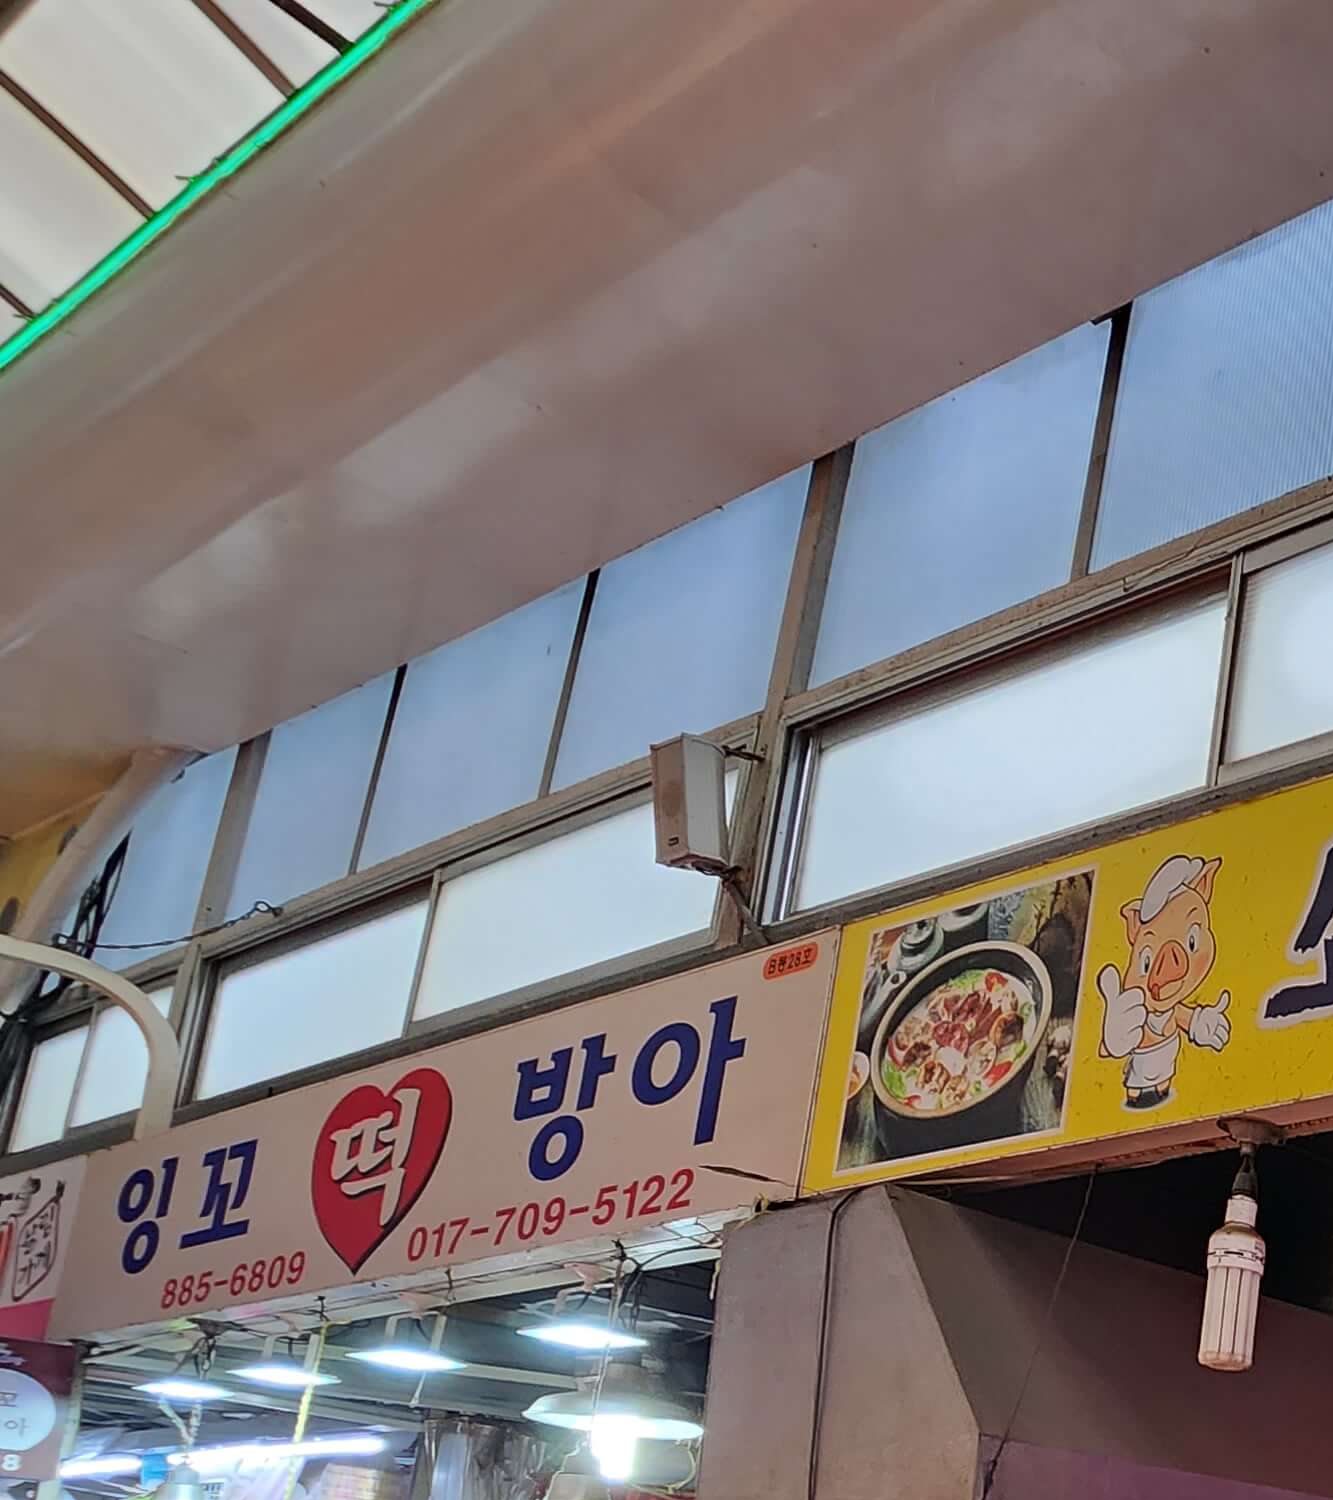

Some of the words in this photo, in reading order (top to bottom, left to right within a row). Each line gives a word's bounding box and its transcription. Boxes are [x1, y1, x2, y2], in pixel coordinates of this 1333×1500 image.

[116, 1137, 260, 1275] 잉꼬
[329, 1086, 424, 1230] 떡
[513, 995, 746, 1181] 방아
[407, 1166, 697, 1264] 017-709-5122
[161, 1250, 306, 1310] 885-6809
